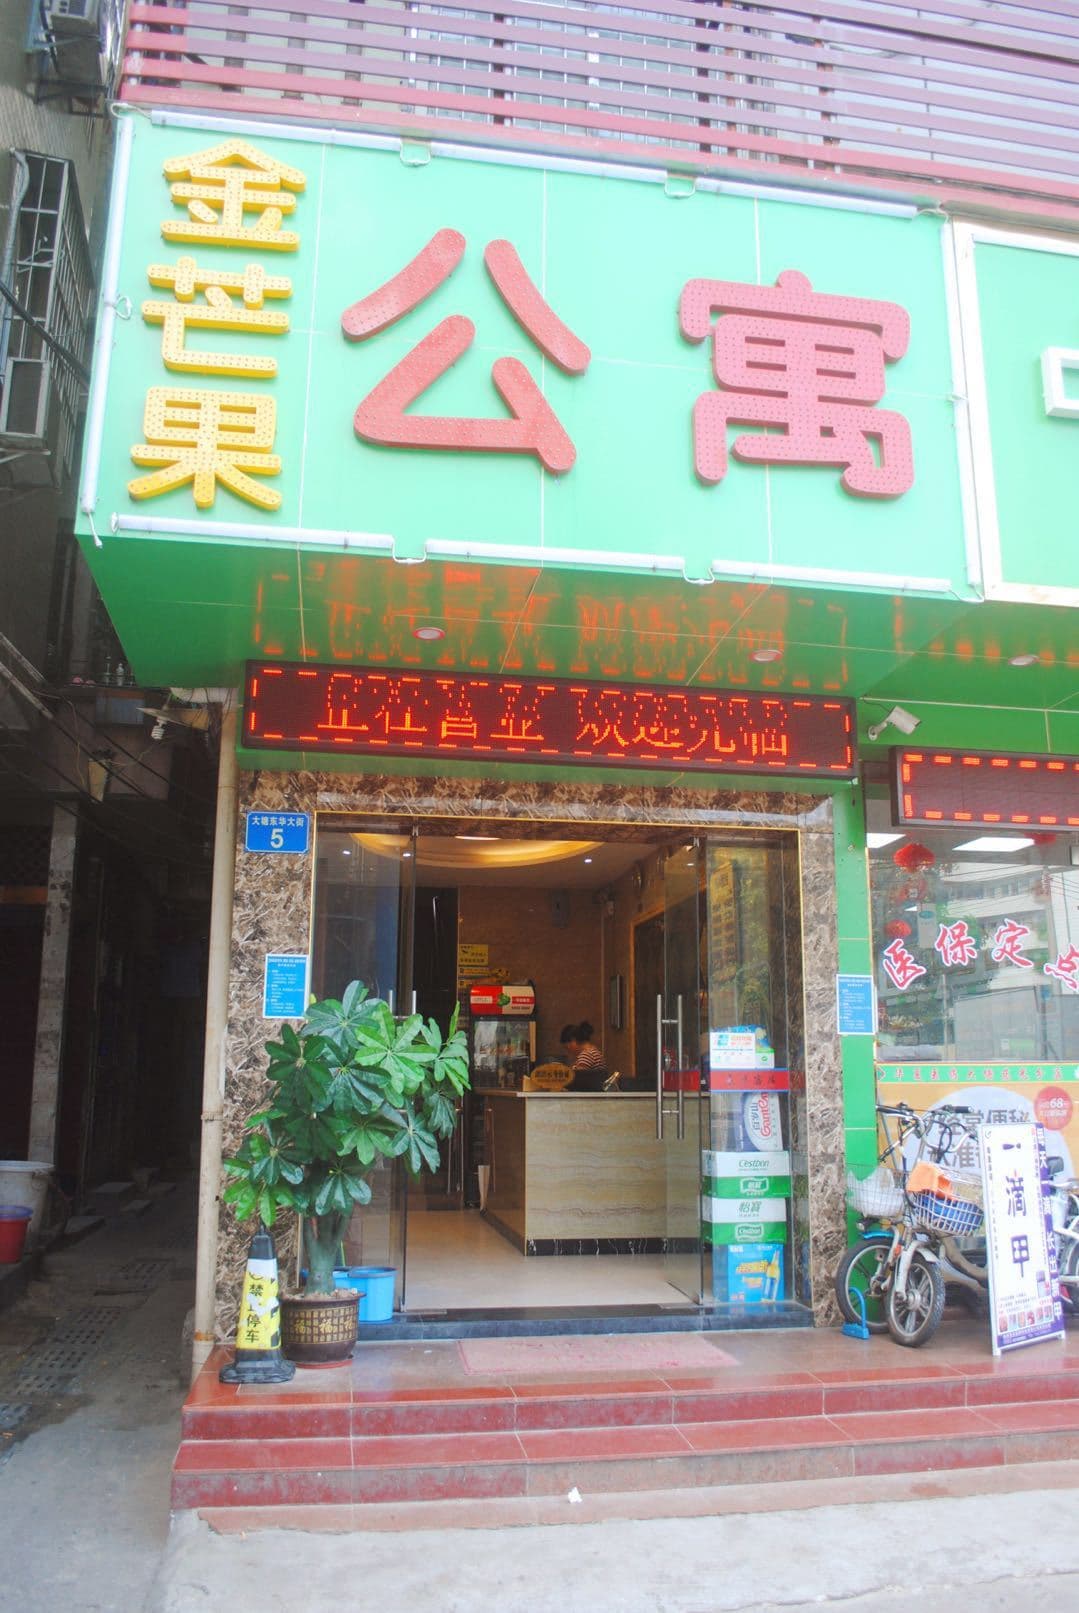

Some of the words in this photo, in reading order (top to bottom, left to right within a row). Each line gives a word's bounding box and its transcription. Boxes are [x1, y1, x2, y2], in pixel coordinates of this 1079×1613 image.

[127, 138, 307, 511] 金芒果
[341, 228, 915, 500] 公寓
[270, 828, 284, 849] 5
